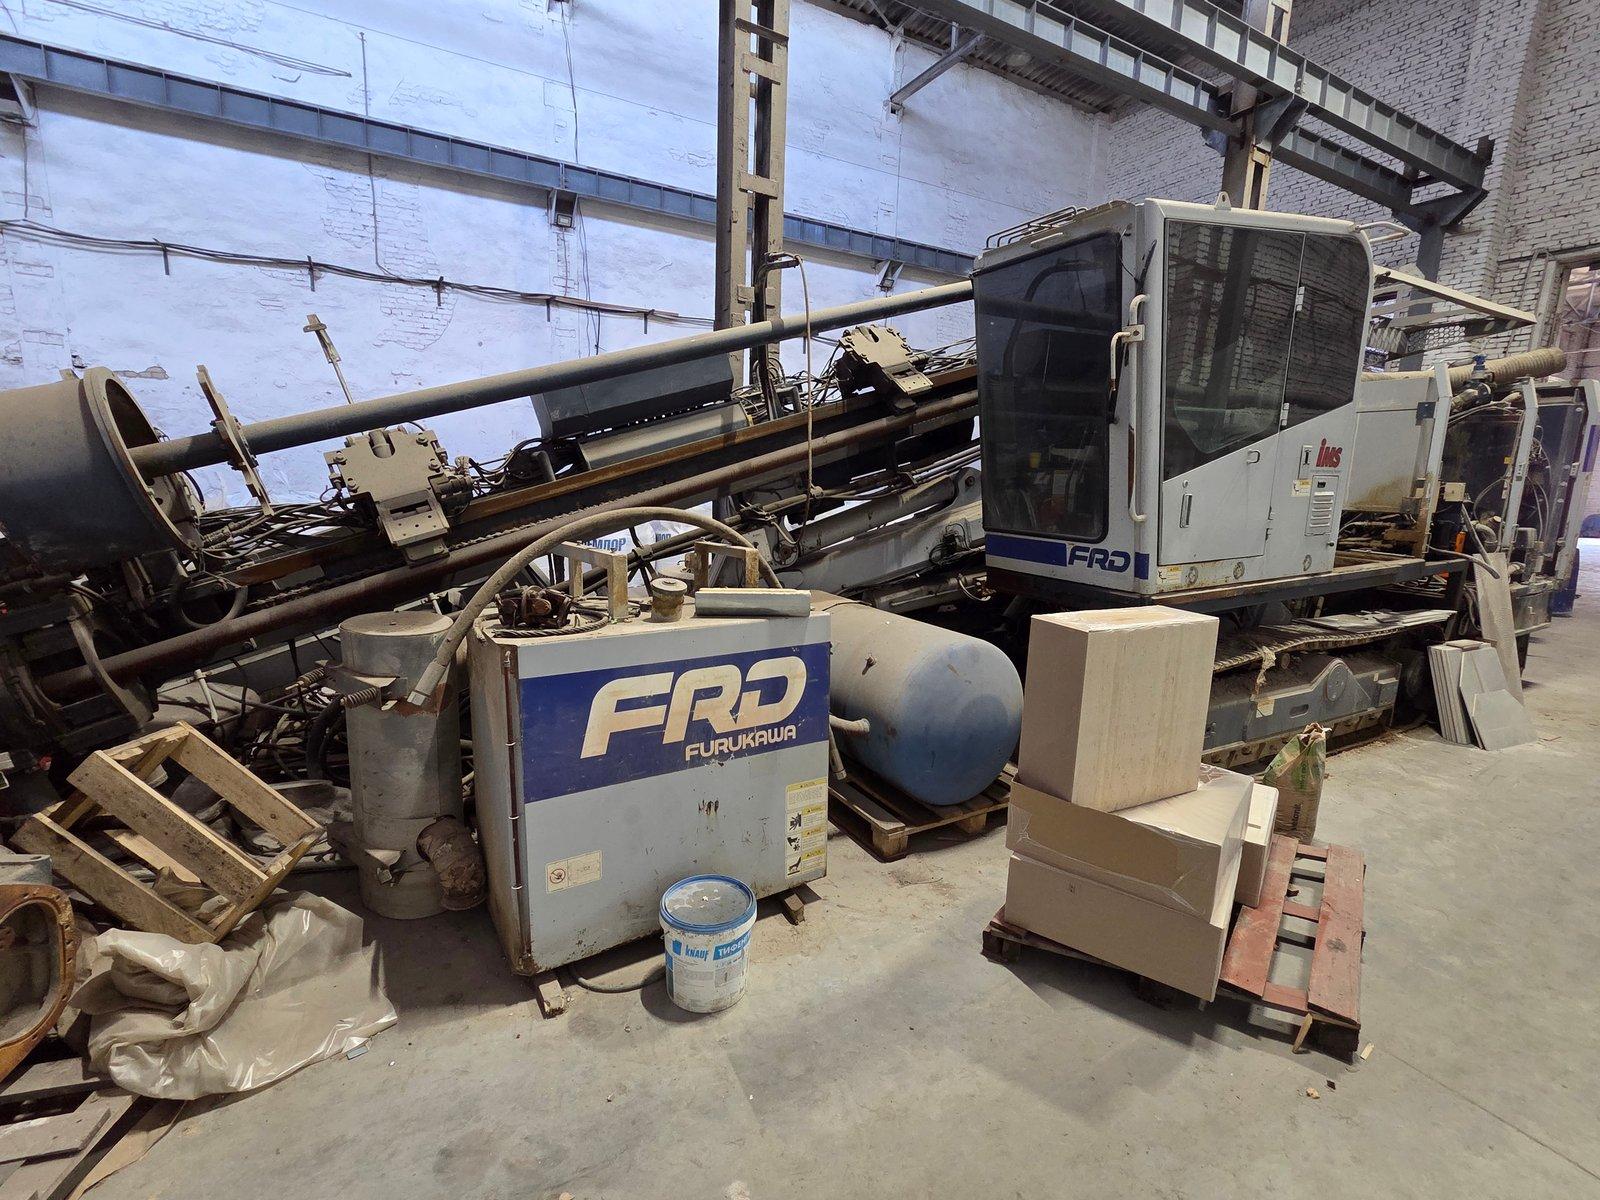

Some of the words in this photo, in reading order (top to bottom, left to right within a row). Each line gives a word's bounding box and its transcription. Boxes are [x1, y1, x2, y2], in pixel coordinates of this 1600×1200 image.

[1068, 545, 1131, 573] FRD
[580, 655, 808, 760] FRD
[685, 724, 797, 762] FURUKAWA
